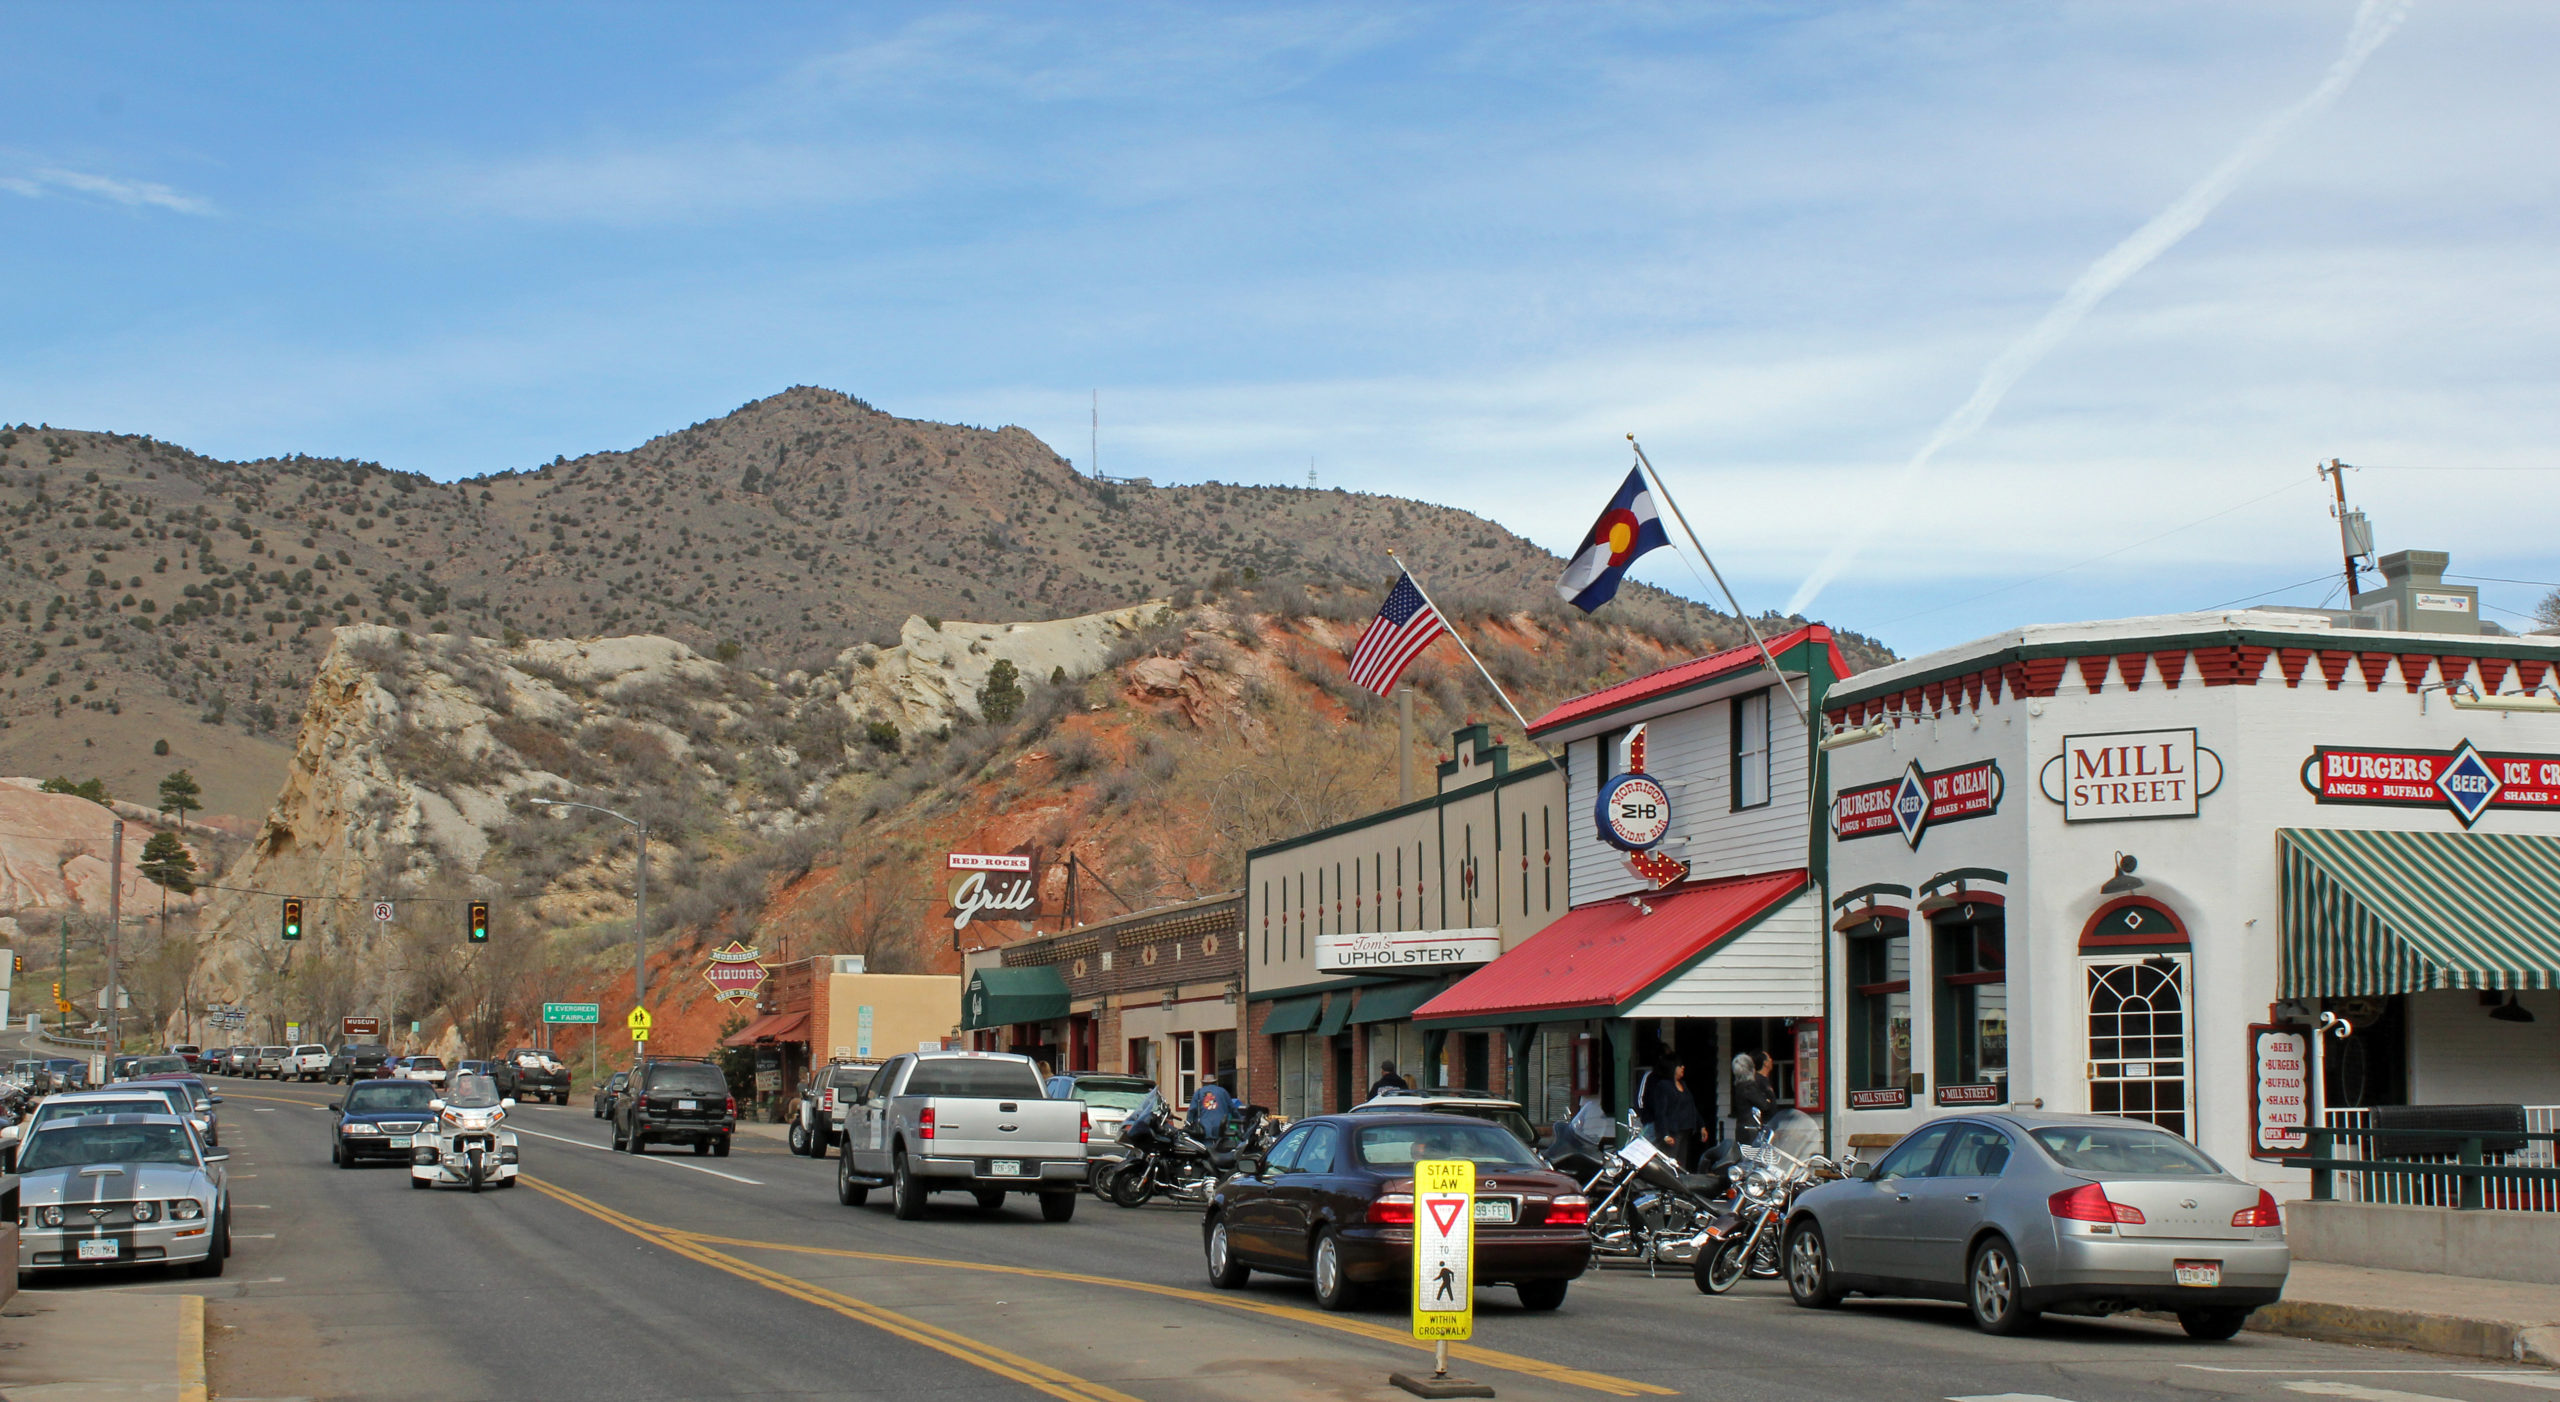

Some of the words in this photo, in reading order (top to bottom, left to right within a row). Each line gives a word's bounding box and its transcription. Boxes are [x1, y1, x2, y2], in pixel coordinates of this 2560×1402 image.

[2073, 743, 2184, 780] MILL
[2327, 755, 2432, 780] BURGERS
[2504, 762, 2531, 785] ICE
[1933, 777, 1949, 801] ICE
[1952, 769, 1987, 797] CREAM
[2452, 774, 2488, 793] BEER
[1611, 781, 1666, 807] MORRISON
[2073, 779, 2186, 807] STREET
[2327, 782, 2367, 796] ANGUS
[2383, 784, 2434, 798] BUFFALO
[2503, 791, 2549, 802] SHAKES
[1840, 788, 1892, 818] BURGERS
[1900, 795, 1920, 815] BEER
[1933, 803, 1958, 816] SHAKES
[1965, 797, 1987, 810] MALTS
[1840, 819, 1860, 833] ANGUS
[1866, 813, 1892, 828] BUFFALO
[1610, 817, 1647, 843] HOLIDAY
[1649, 818, 1668, 839] BAR
[952, 857, 979, 865] RED
[985, 858, 1027, 867] ROCKS
[953, 871, 1035, 930] Grill
[1353, 935, 1392, 951] Tom's
[712, 949, 759, 961] MORRISON
[1338, 947, 1466, 966] UPHOLSTERY
[710, 969, 763, 980] LIQUORS
[555, 1005, 596, 1013] EVERGREEN
[2273, 1042, 2293, 1053] BEER
[2267, 1060, 2299, 1071] BURGERS
[2267, 1078, 2300, 1088] BUFFALO
[1858, 1092, 1874, 1103] MILL
[1874, 1091, 1897, 1103] STREET
[1946, 1088, 1962, 1099] MILL
[1963, 1087, 1989, 1099] STREET
[2268, 1096, 2299, 1106] SHAKES
[2270, 1113, 2297, 1123] MALTS
[1427, 1164, 1464, 1176] STATE
[1433, 1179, 1459, 1190] LAW
[1440, 1245, 1449, 1255] TO
[1429, 1315, 1457, 1324] WITHIN
[1419, 1326, 1466, 1336] CROSSWALK
